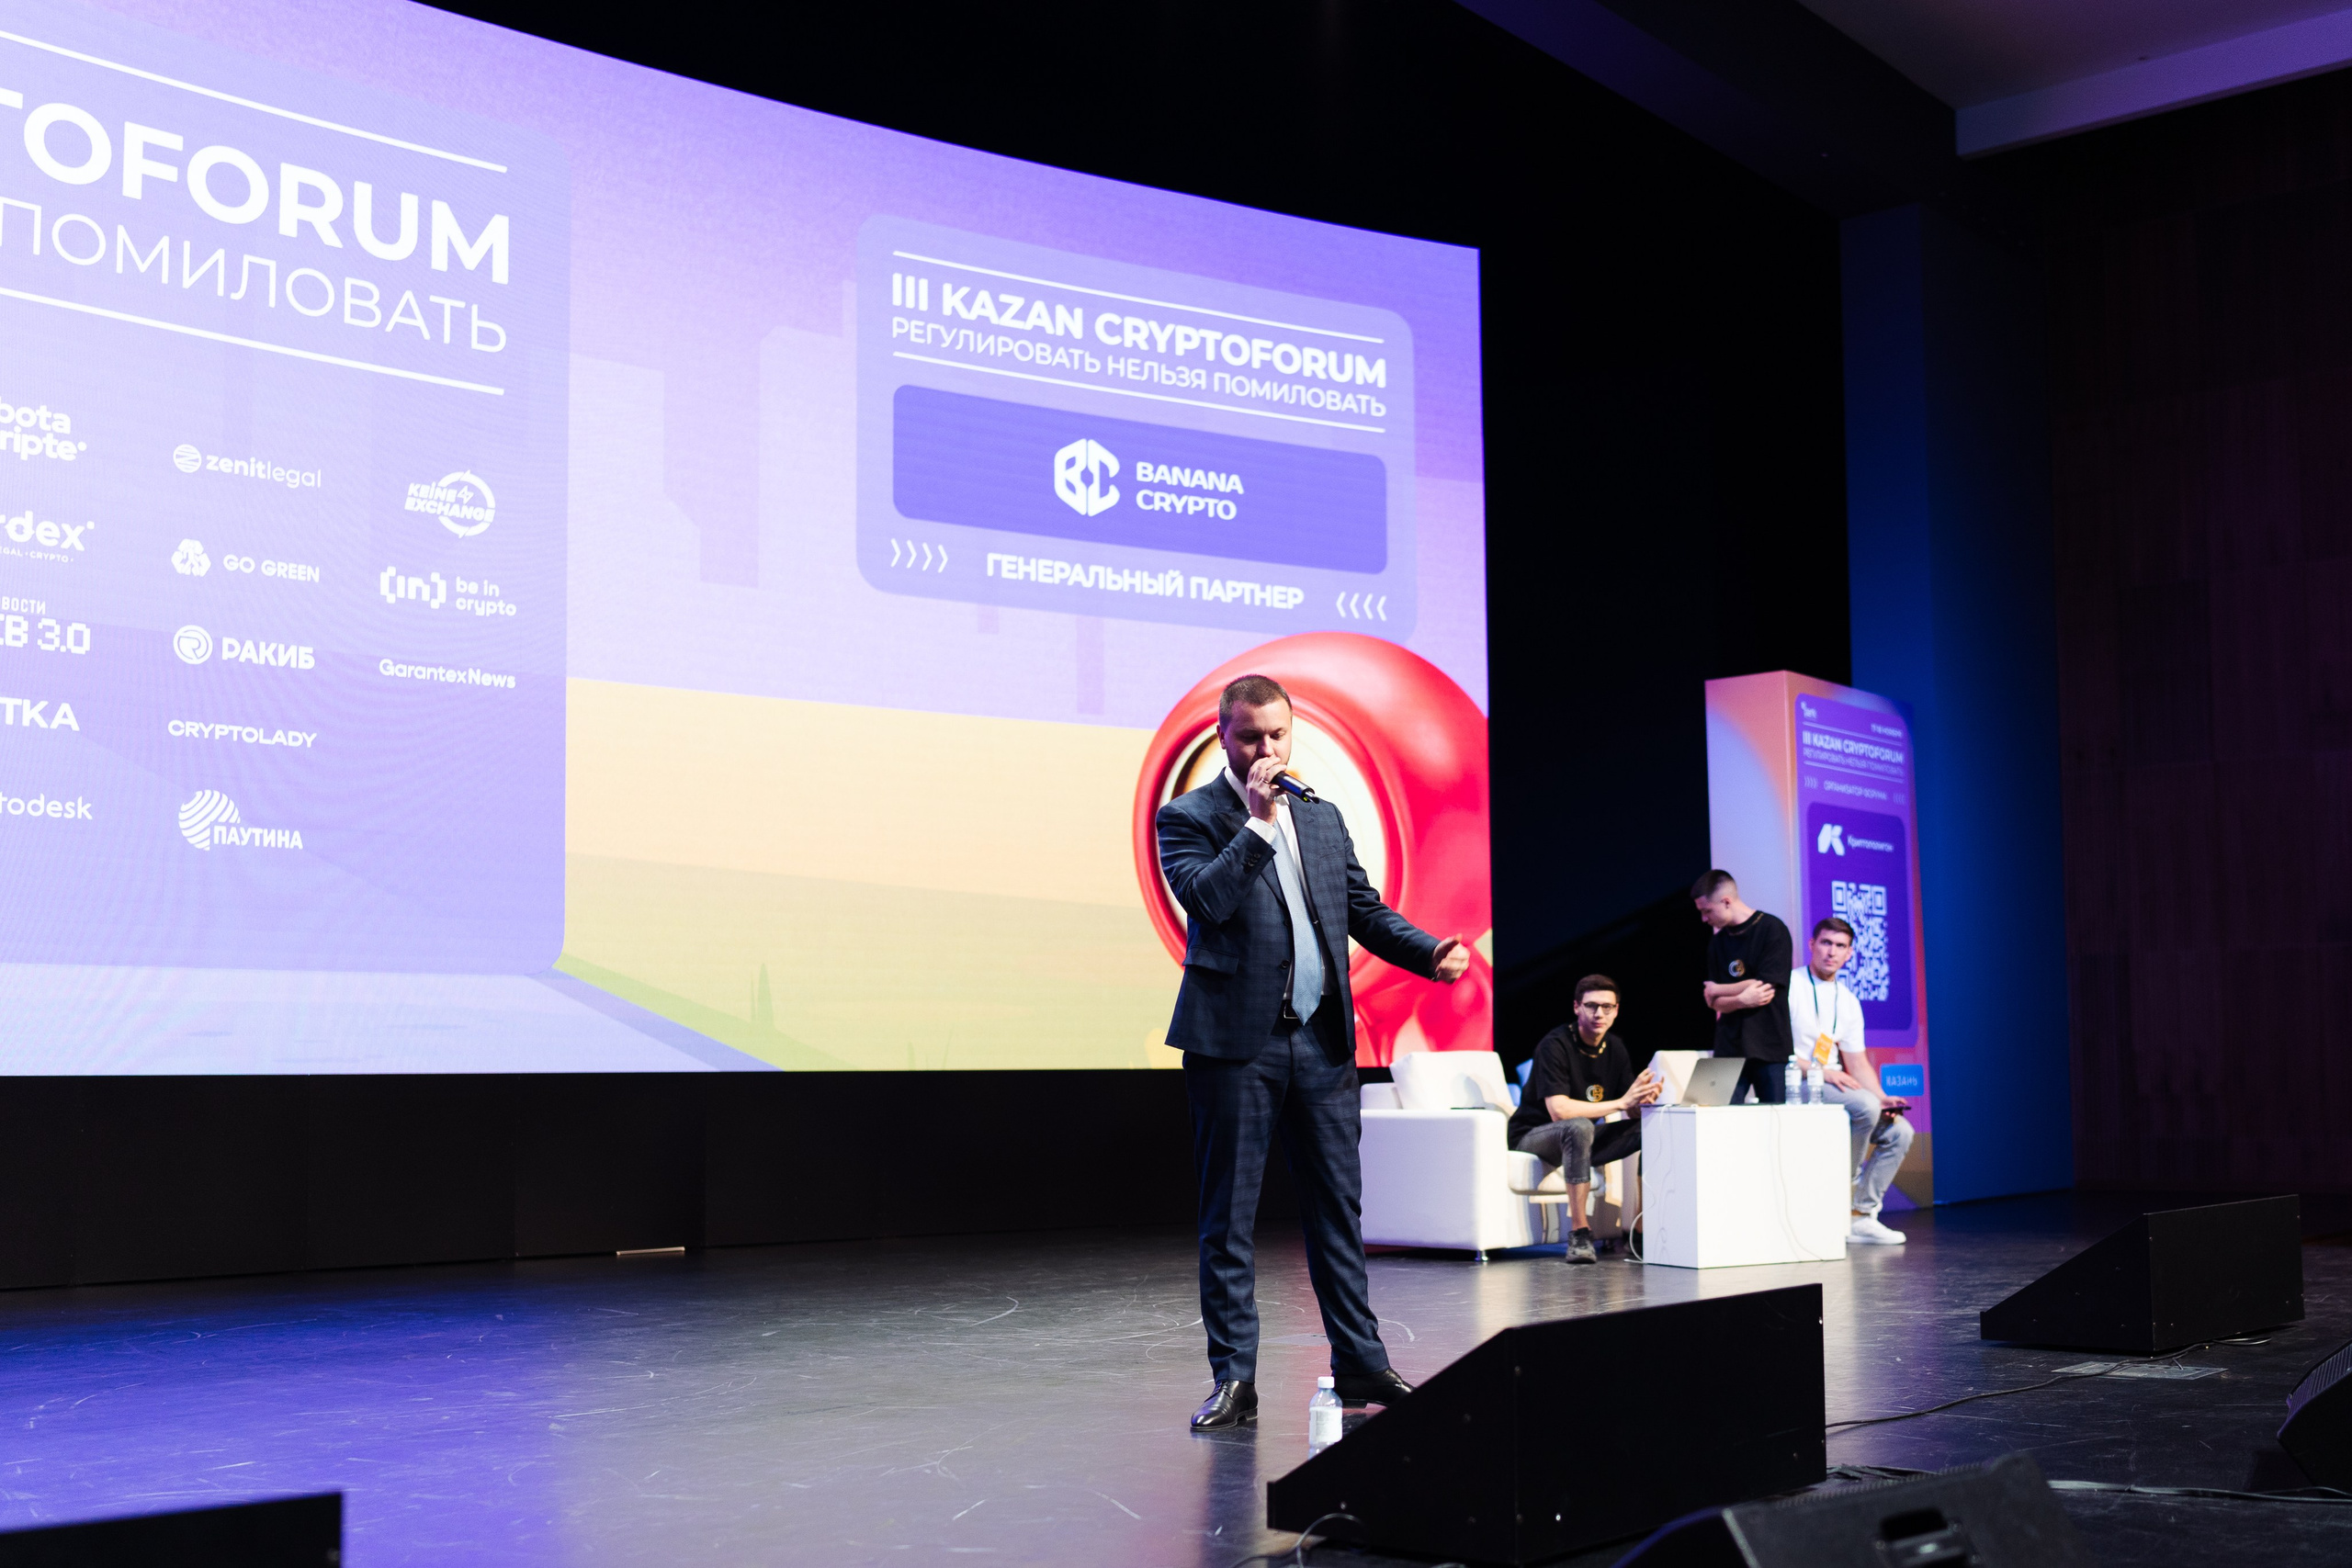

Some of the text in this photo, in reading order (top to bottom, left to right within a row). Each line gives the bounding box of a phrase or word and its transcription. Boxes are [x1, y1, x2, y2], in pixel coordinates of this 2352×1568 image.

[0, 196, 507, 353] ПОМИЛОВАТЬ
[892, 273, 1386, 389] III KAZAN CRYPTOFORUM
[892, 317, 1386, 417] РЕГУЛИРОВАТЬ НЕЛЬЗЯ ПОМИЛОВАТЬ
[206, 455, 321, 489] zenitlegal
[1136, 462, 1243, 494] BANANA
[404, 497, 495, 523] EXCHANGE
[1136, 491, 1237, 520] CRYPTO
[223, 554, 320, 582] GO GREEN
[987, 553, 1305, 609] ГЕНЕРАЛЬНЫЙ ПАРТНЕР
[456, 576, 500, 597] be in
[456, 598, 516, 616] crypto
[38, 617, 91, 655] 3.0
[221, 637, 315, 670] РАКИБ
[379, 659, 516, 689] GarantexNews
[167, 719, 317, 749] CRYPTOLADY
[213, 825, 303, 850] ПАУТИНА
